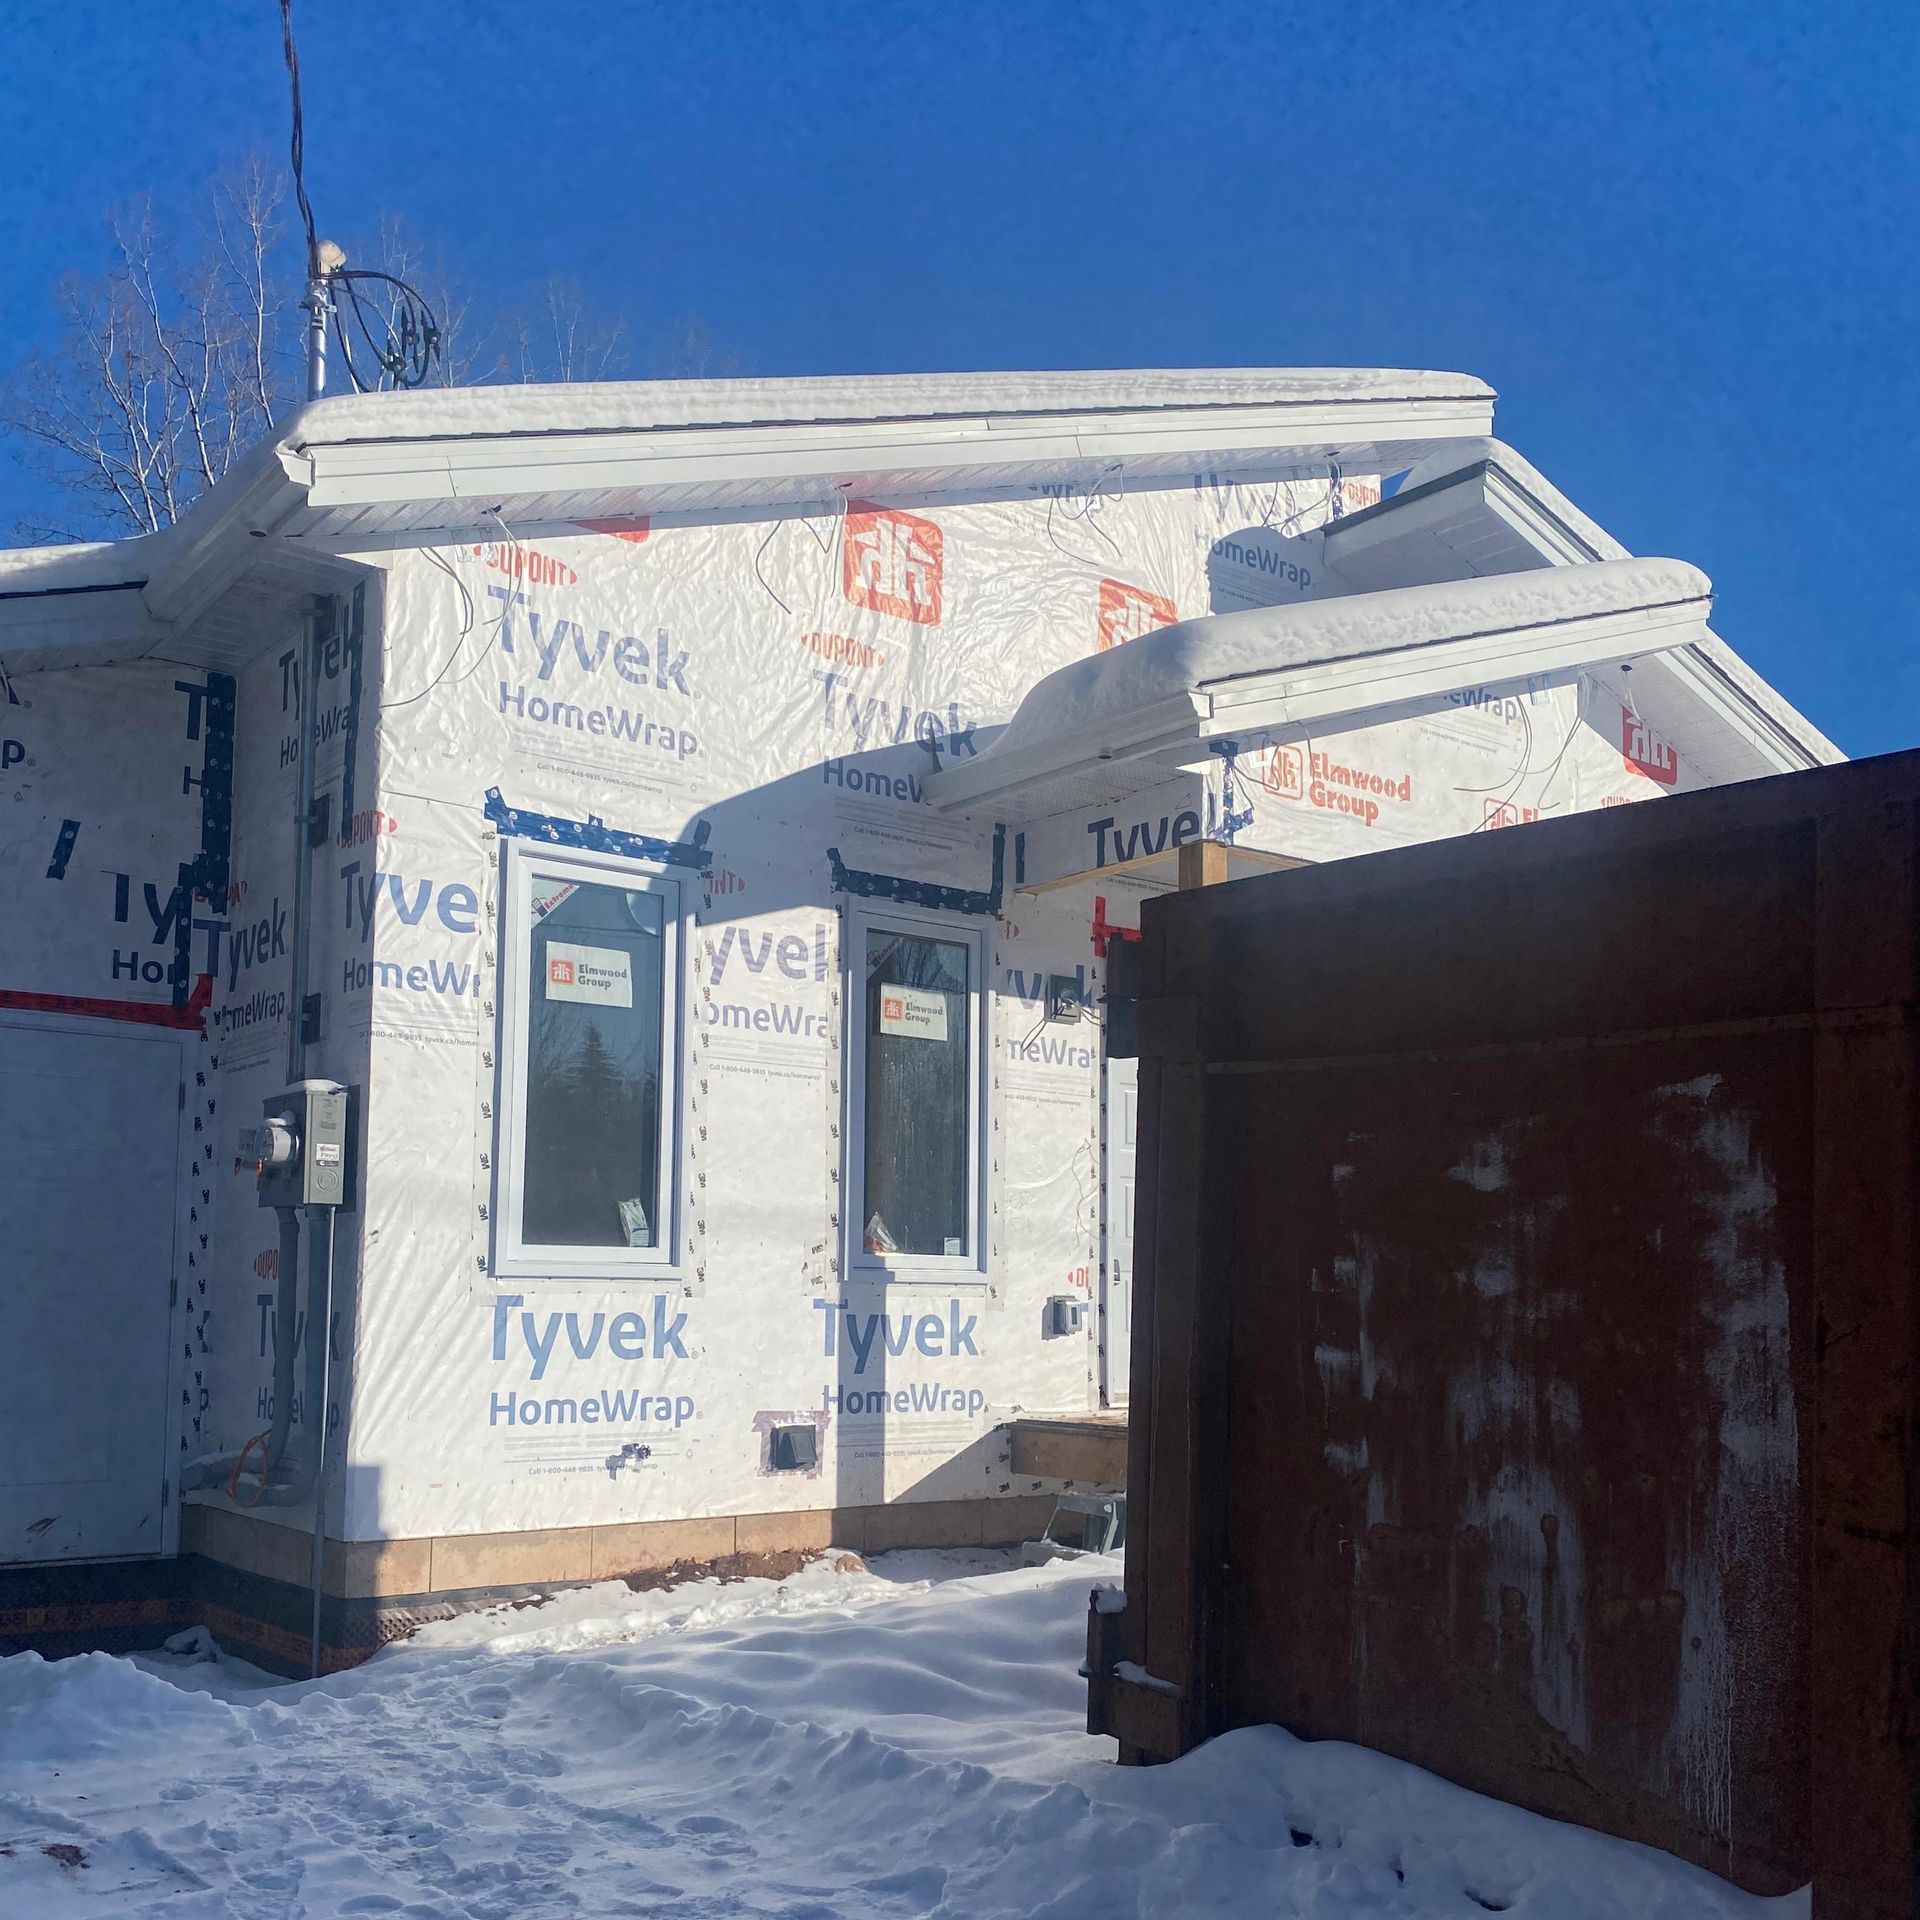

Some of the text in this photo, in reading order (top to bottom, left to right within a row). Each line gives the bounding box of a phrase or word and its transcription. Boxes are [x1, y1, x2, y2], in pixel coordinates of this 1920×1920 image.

[488, 585, 691, 696] Tyvek
[812, 632, 876, 668] DUPONT
[500, 682, 698, 760] HomeWrap
[813, 670, 978, 757] Tyvek
[1310, 752, 1411, 802] Elmwood
[1309, 780, 1379, 828] Group
[489, 851, 497, 867] 3M
[486, 901, 495, 917] 3M
[192, 897, 287, 992] Tyvek
[485, 952, 495, 967] 3M
[578, 964, 627, 979] Elmwood
[578, 975, 611, 990] Group
[484, 1001, 494, 1018] 3M
[905, 1002, 943, 1016] Elmwood
[905, 1012, 931, 1026] Group
[483, 1052, 493, 1068] 3M
[481, 1102, 491, 1119] 3M
[480, 1153, 490, 1169] 3M
[478, 1204, 488, 1221] 3M
[477, 1256, 487, 1272] 3M
[492, 1295, 690, 1380] Tyvek
[813, 1299, 979, 1375] Tyvek
[489, 1389, 695, 1428] HomeWrap
[822, 1383, 984, 1418] HomeWrap
